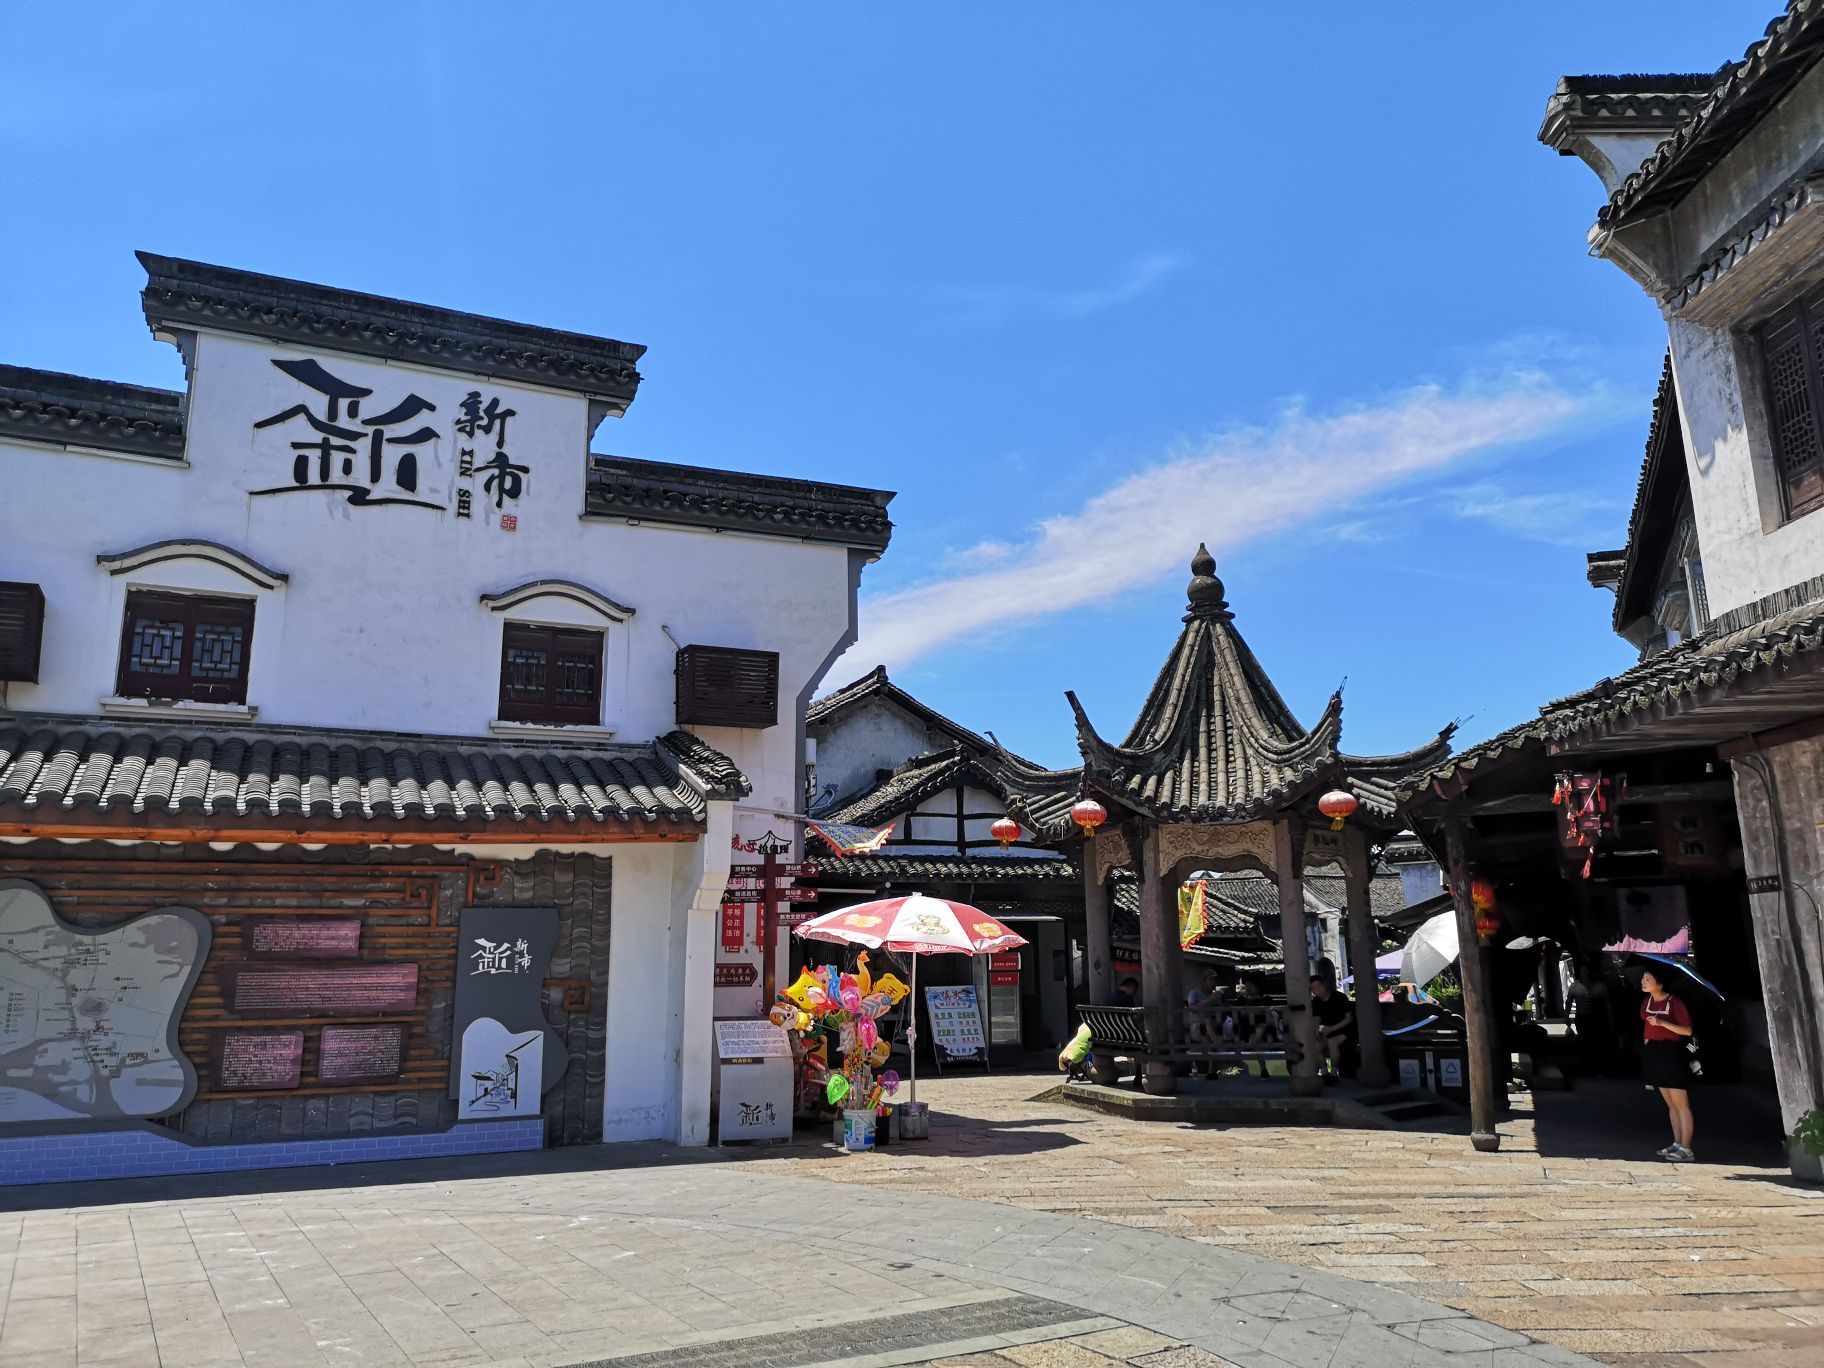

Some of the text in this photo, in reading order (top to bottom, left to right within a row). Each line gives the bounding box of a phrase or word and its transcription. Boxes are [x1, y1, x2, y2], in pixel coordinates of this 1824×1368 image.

[455, 391, 530, 509] 新市
[456, 446, 474, 519] XIN SHI
[726, 908, 741, 916] 平等
[726, 919, 741, 927] 公正
[726, 929, 741, 937] 法治
[514, 938, 532, 970] 新市
